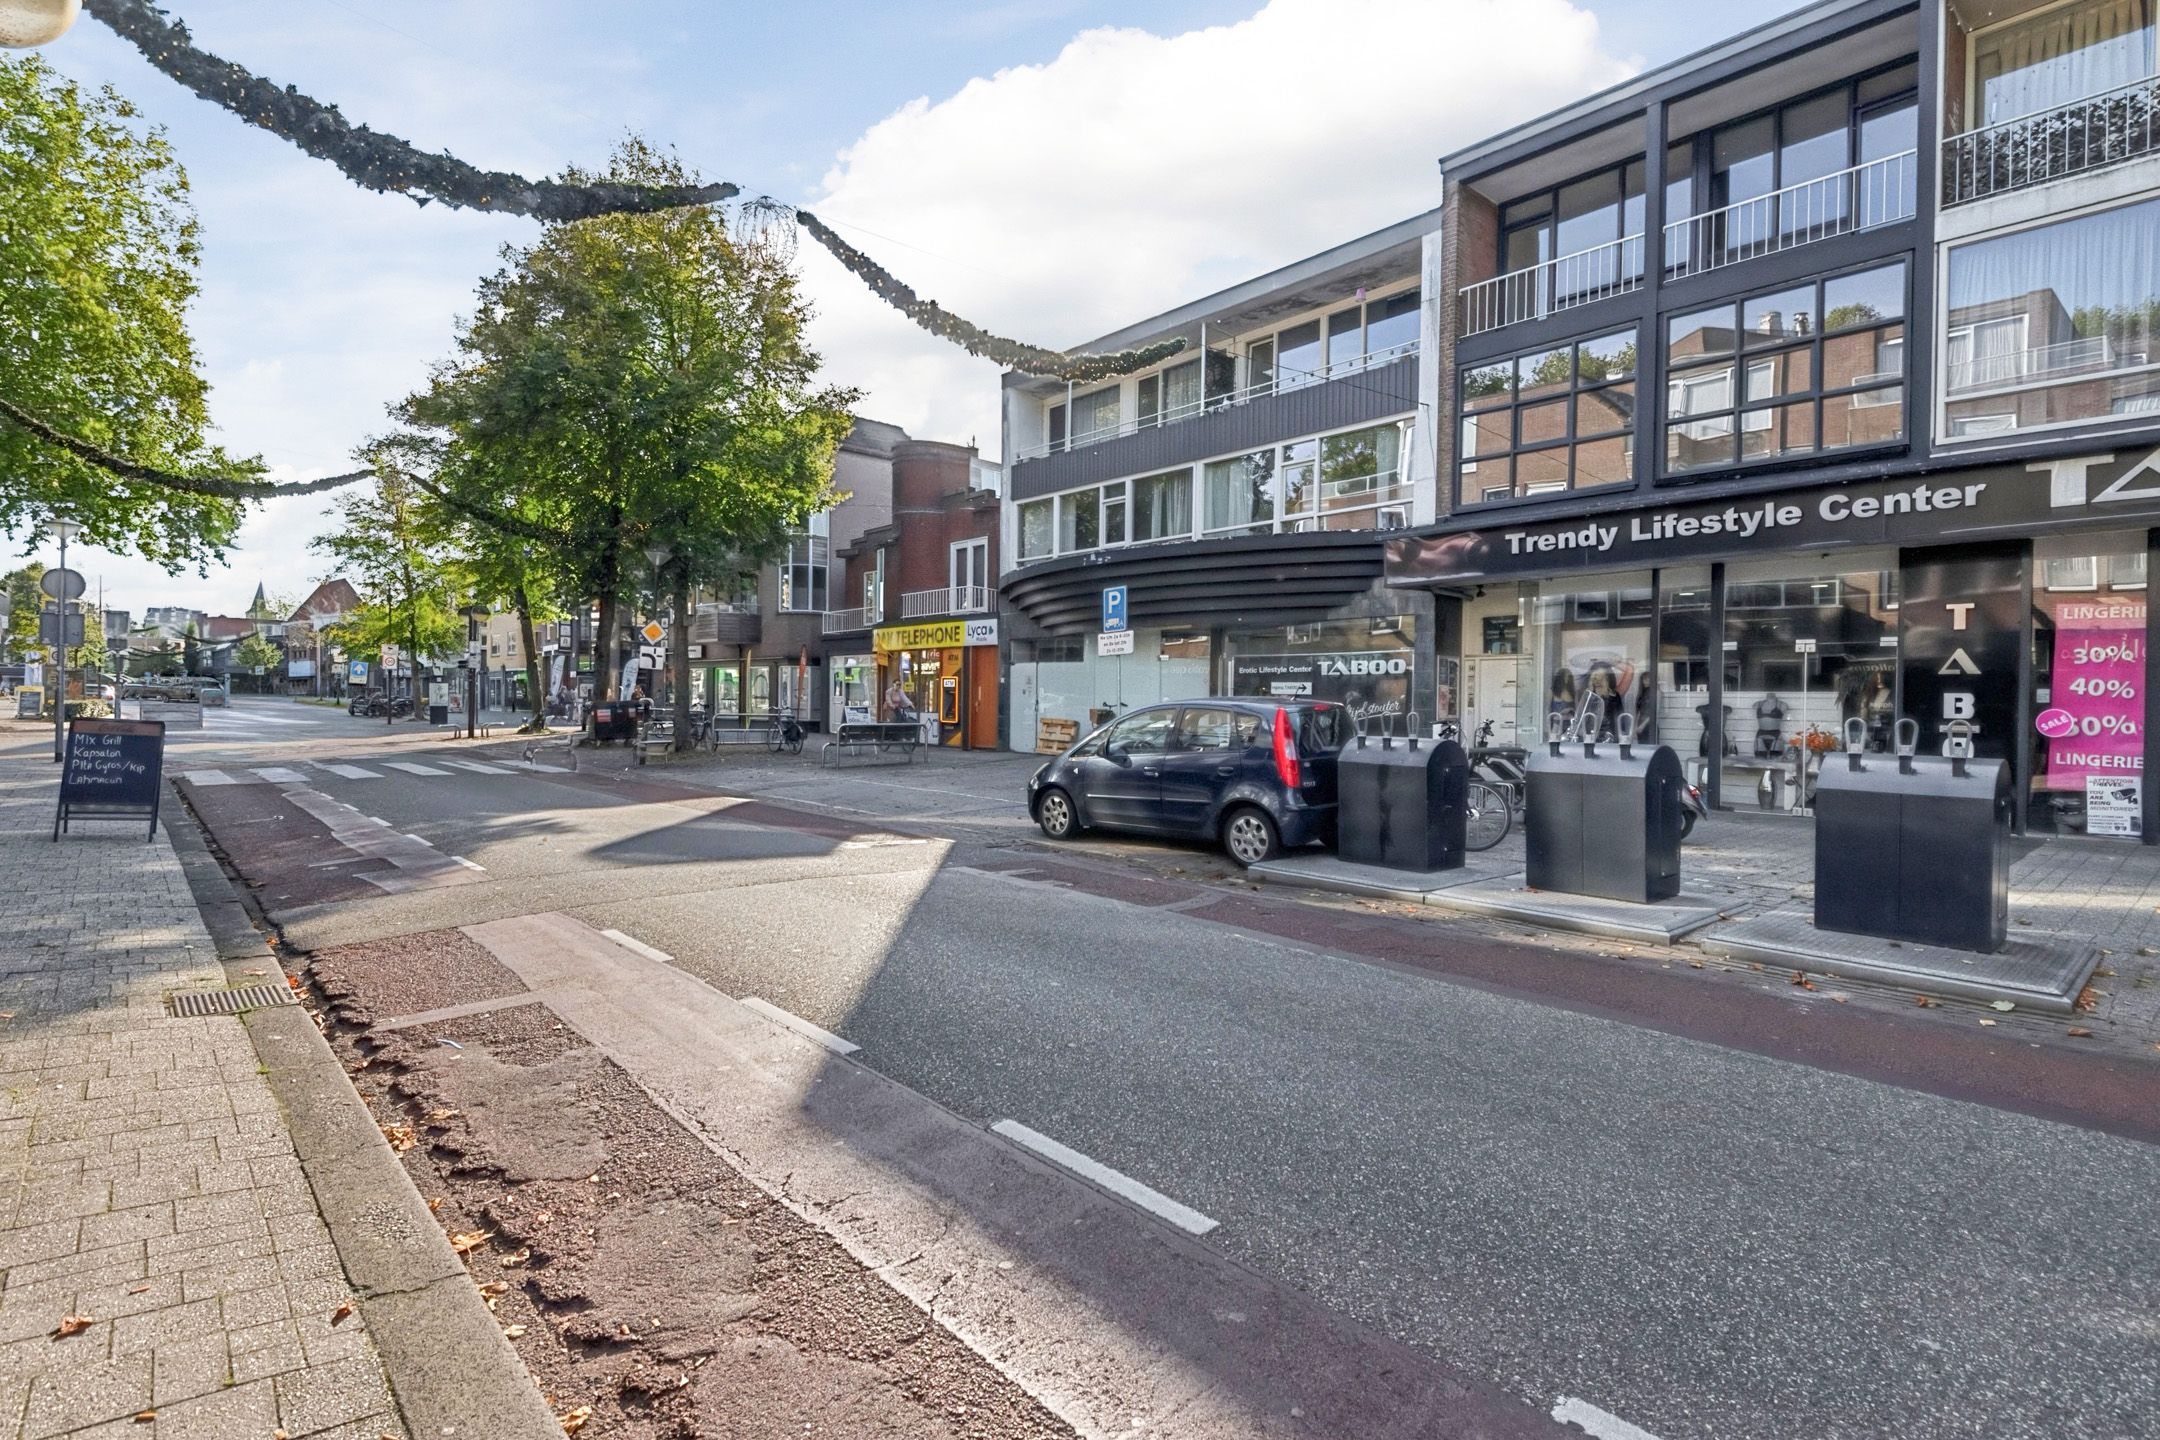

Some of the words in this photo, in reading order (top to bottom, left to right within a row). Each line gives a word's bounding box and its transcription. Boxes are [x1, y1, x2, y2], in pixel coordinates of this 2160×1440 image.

[1504, 523, 1618, 555] Trendy
[1631, 502, 1803, 541] Lifestyle
[1818, 484, 1987, 522] Center
[1108, 591, 1121, 614] P
[896, 625, 961, 647] TELEPHONE
[967, 625, 988, 638] Lyca
[2073, 645, 2135, 665] 30%
[1259, 666, 1287, 674] Lifestyle
[1317, 659, 1406, 676] TABOO
[2069, 678, 2135, 699] 40%
[1368, 700, 1400, 715] stouter
[2041, 714, 2069, 731] SALE
[102, 735, 122, 745] Grill
[73, 746, 121, 760] Kapsalon
[2055, 752, 2144, 769] LINGERIE
